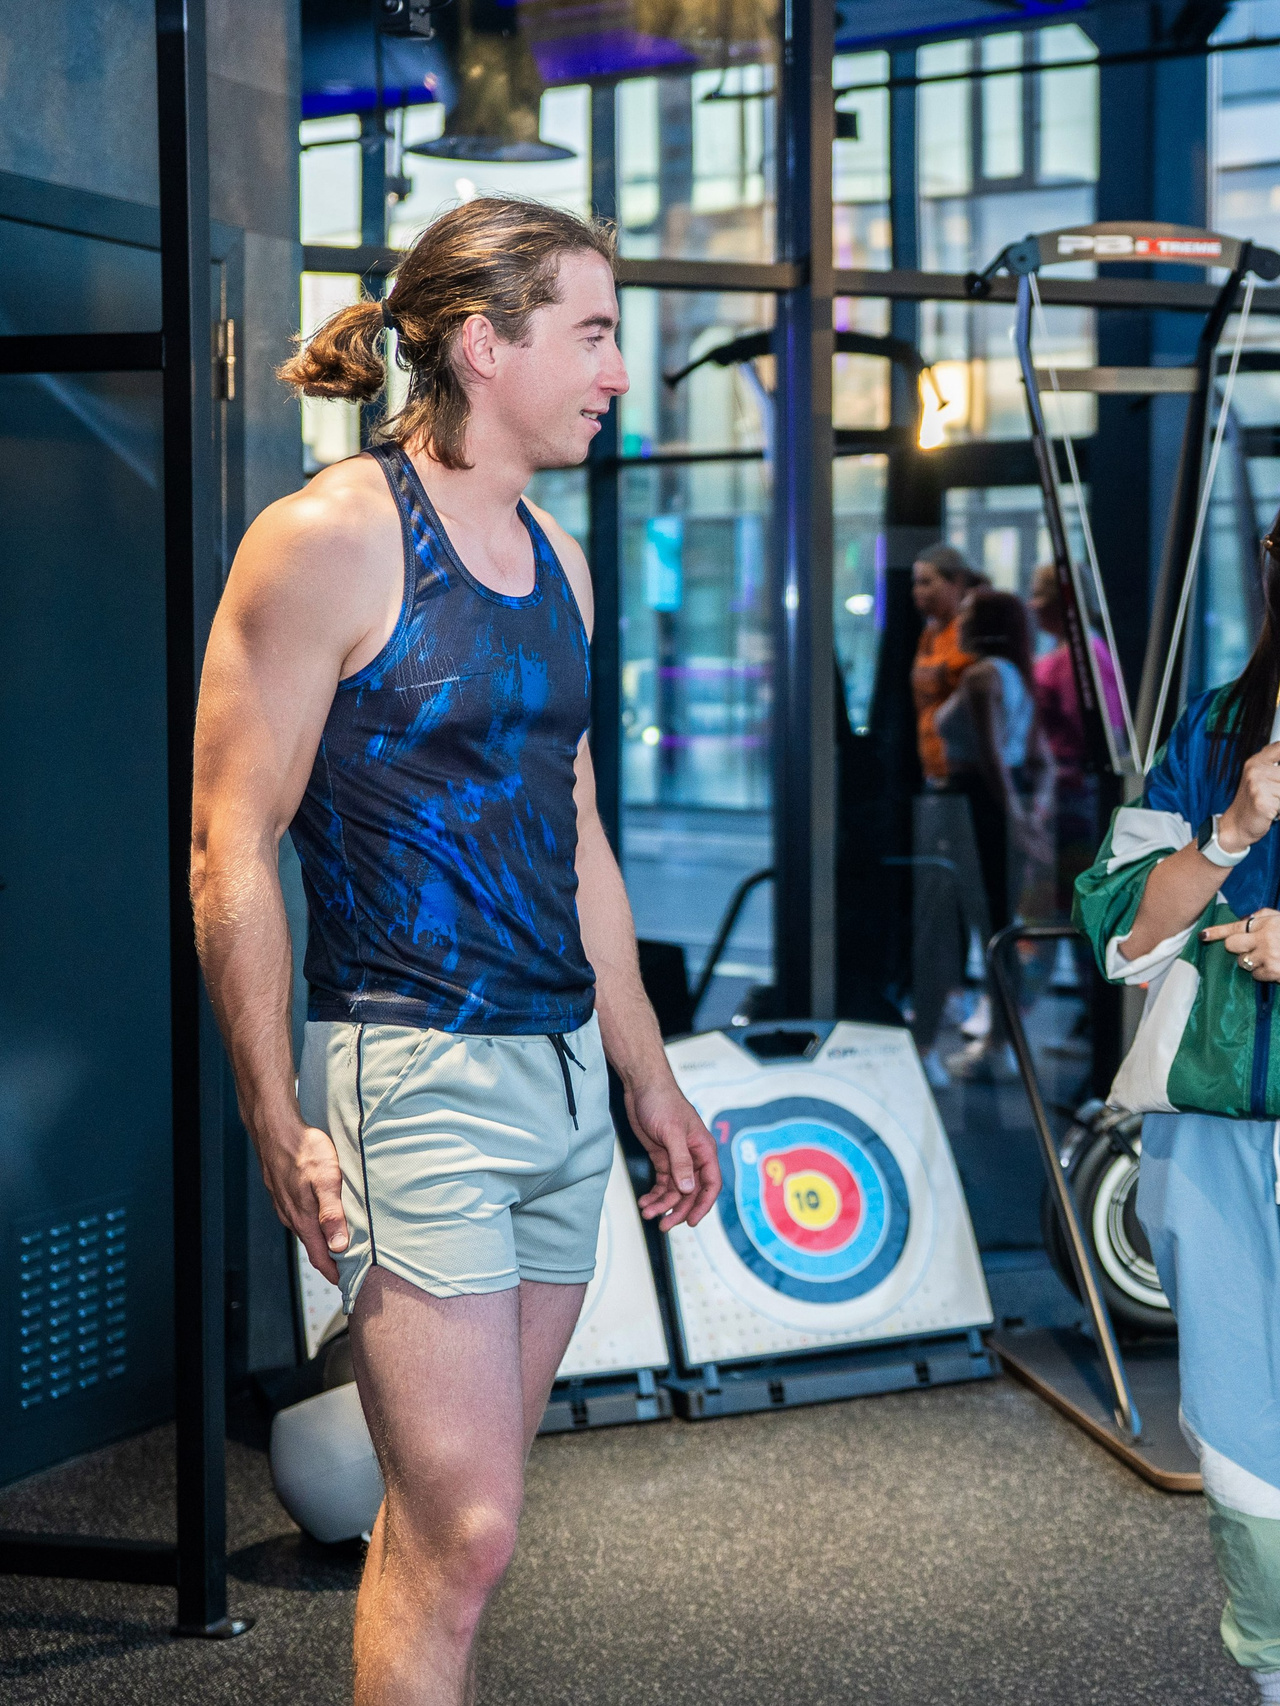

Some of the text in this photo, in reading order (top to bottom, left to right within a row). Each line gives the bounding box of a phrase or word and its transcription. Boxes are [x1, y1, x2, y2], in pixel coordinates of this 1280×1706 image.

[715, 1120, 730, 1144] 7
[740, 1140, 757, 1165] 8
[765, 1159, 785, 1186] 9
[794, 1190, 820, 1211] 10
